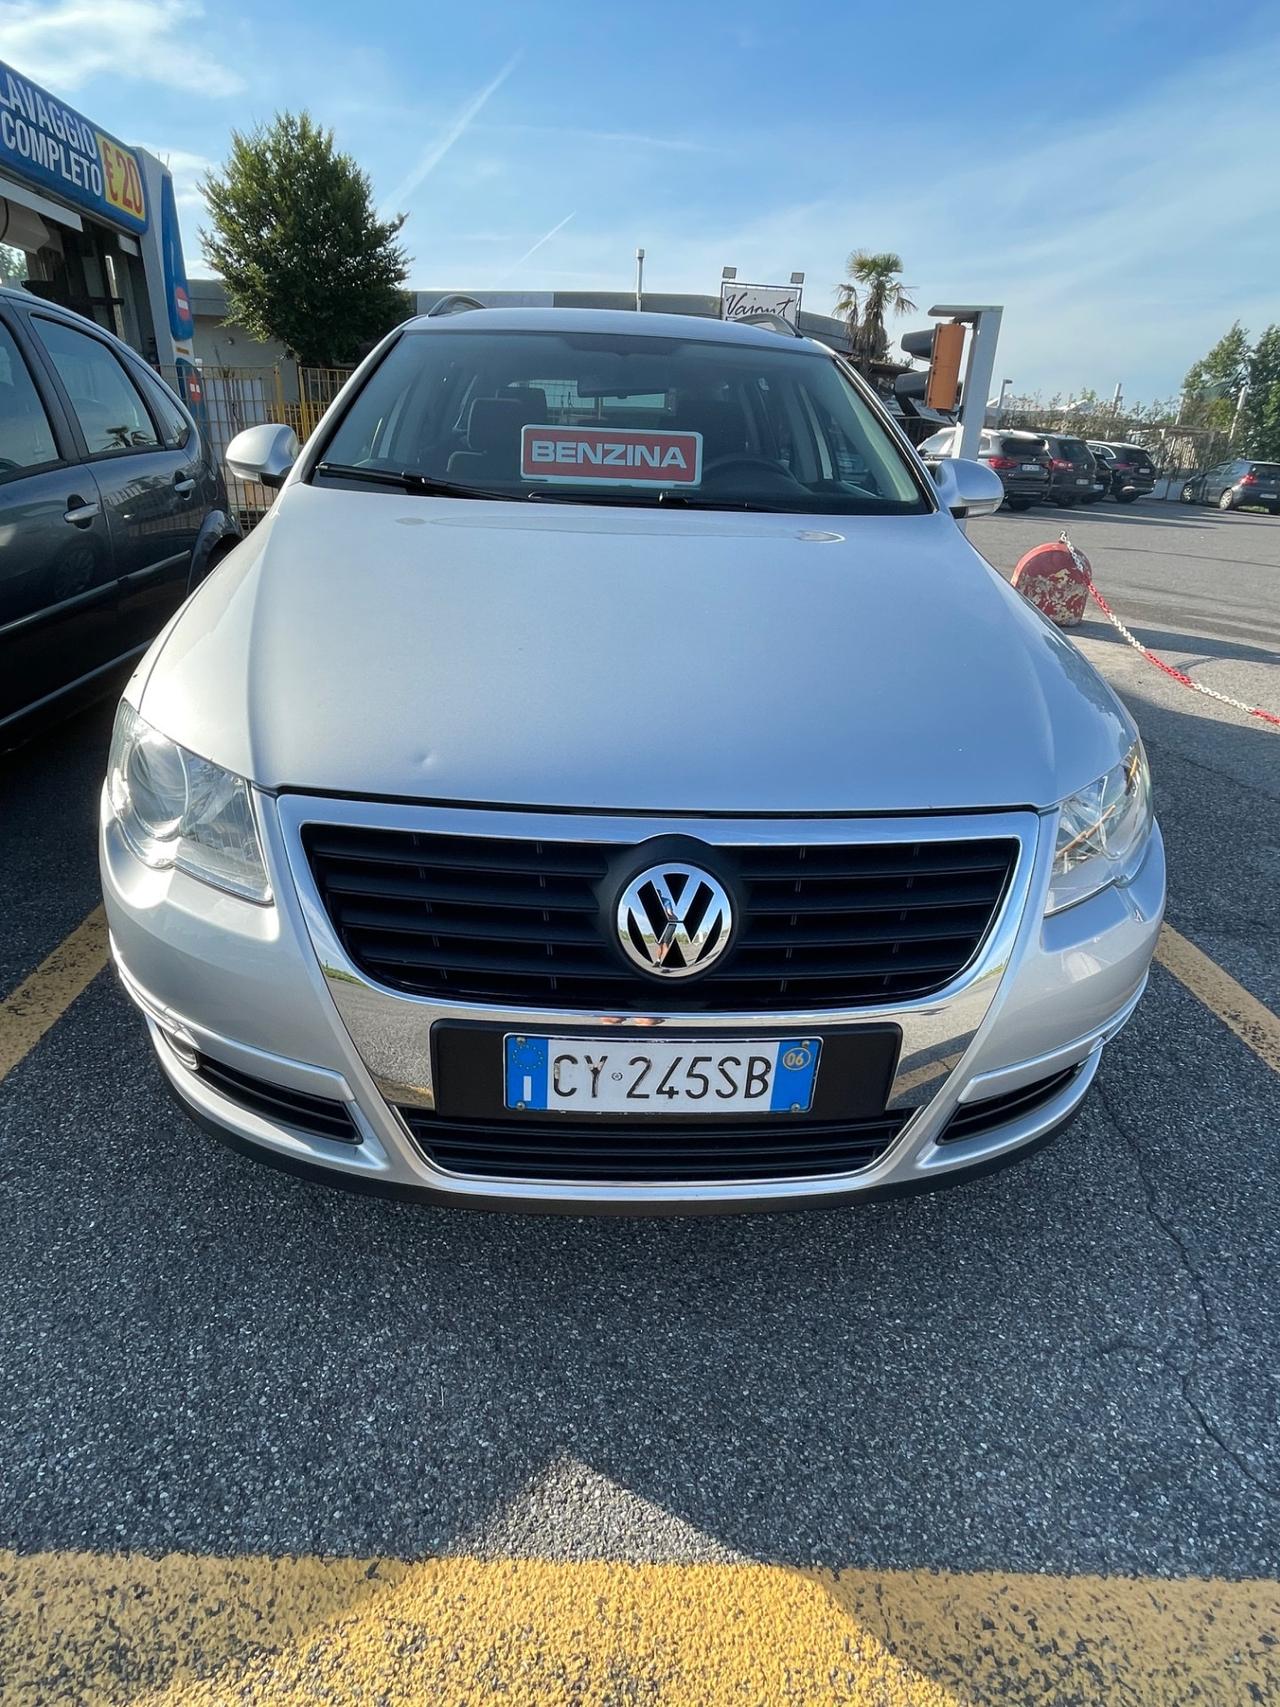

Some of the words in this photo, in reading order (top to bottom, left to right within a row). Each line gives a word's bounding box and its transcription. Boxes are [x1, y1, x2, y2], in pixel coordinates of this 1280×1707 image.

[1, 110, 102, 197] COMPLETO
[531, 440, 687, 469] BENZINA
[553, 1054, 608, 1098] CY
[626, 1055, 772, 1099] 245SB
[785, 1052, 804, 1066] 06
